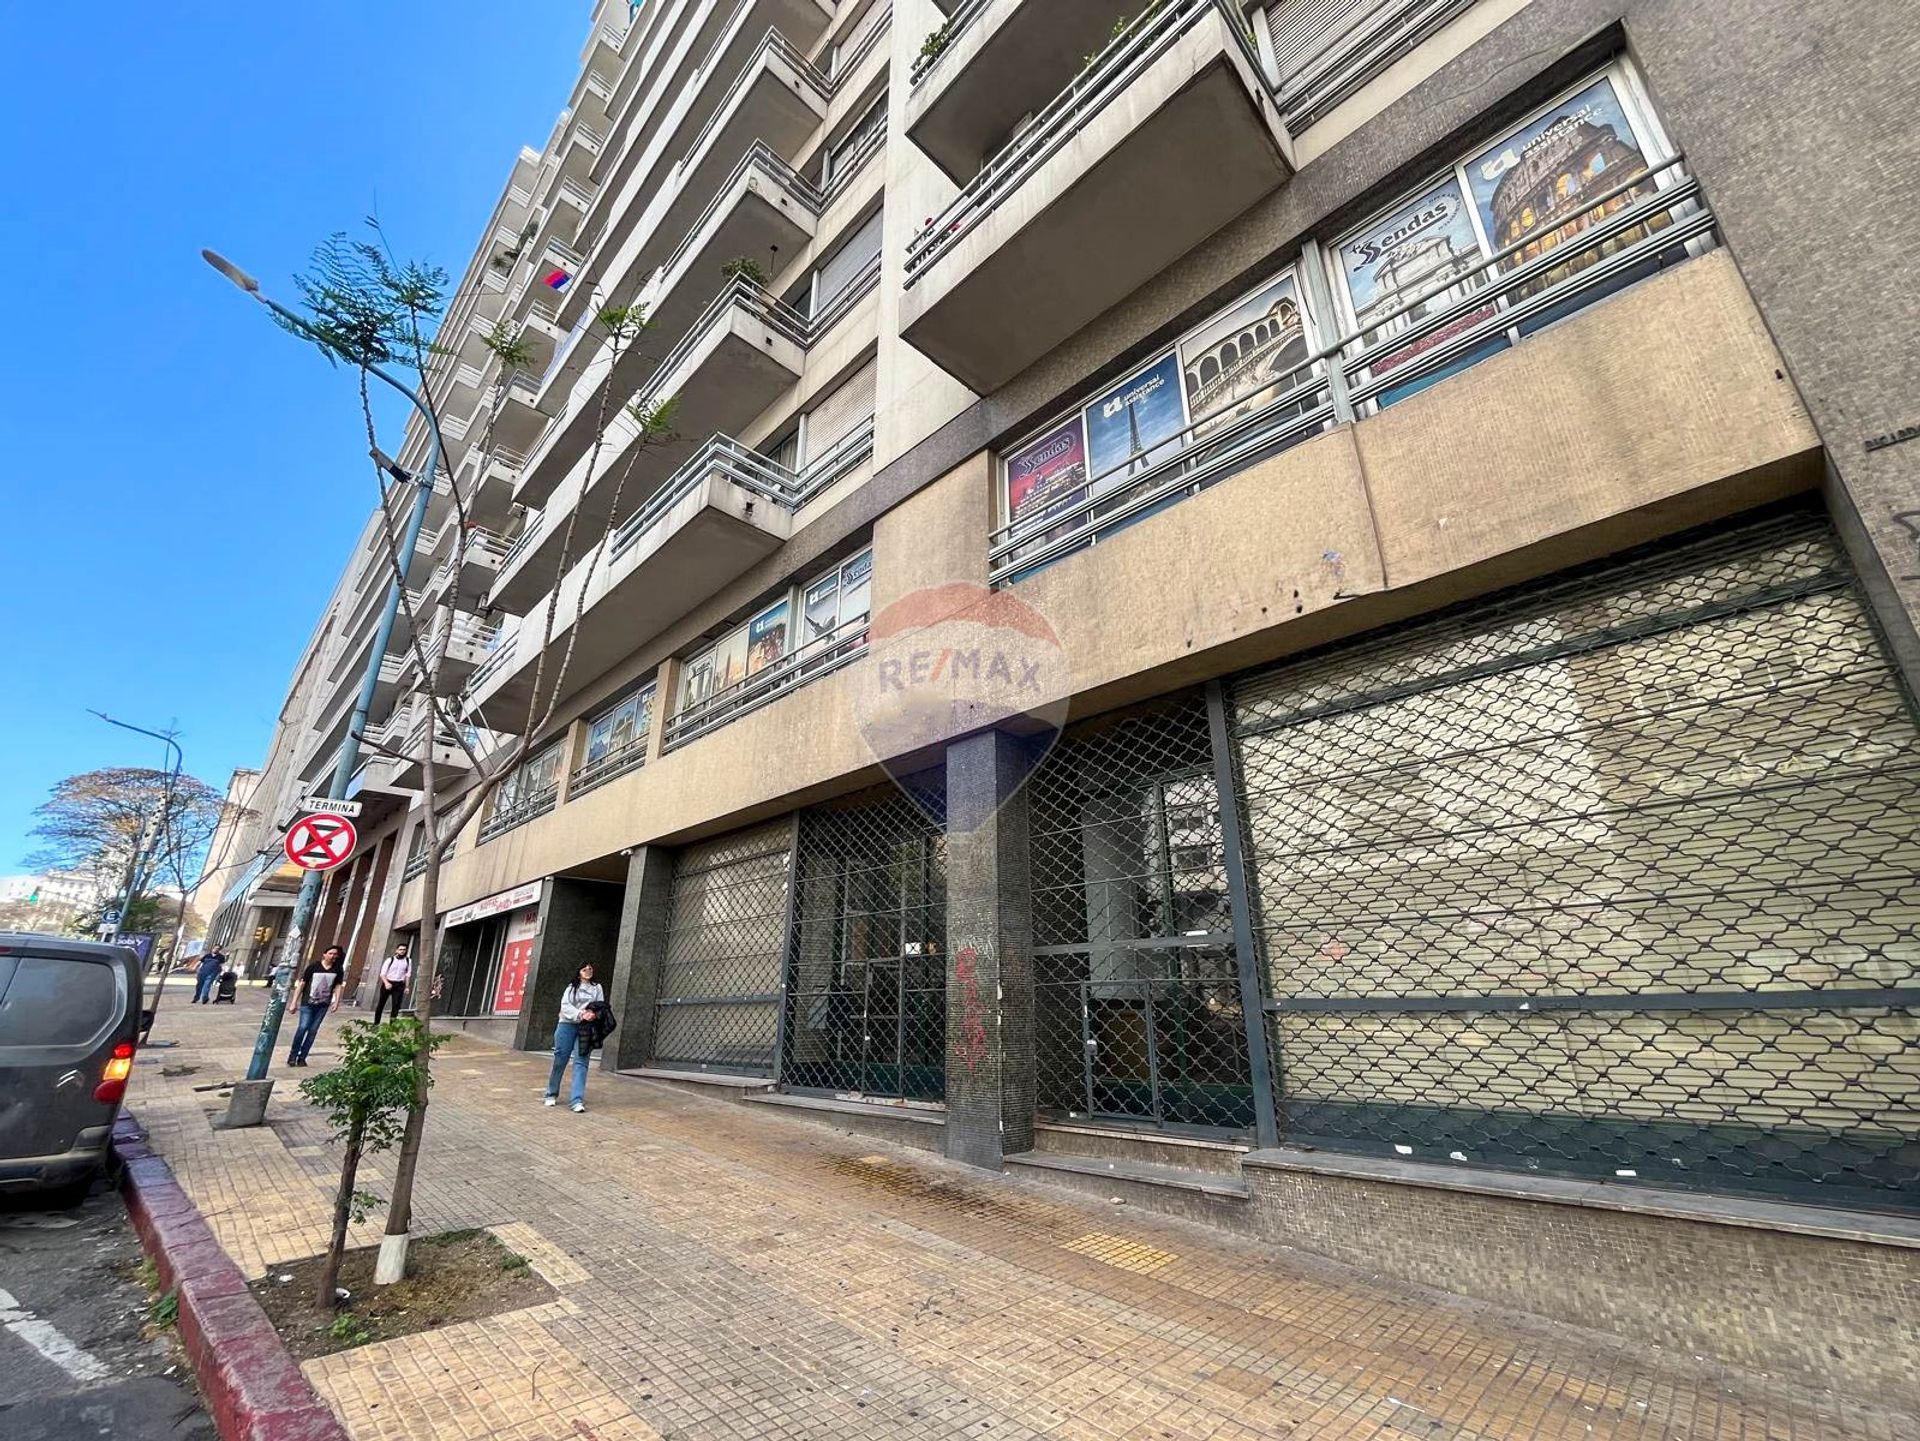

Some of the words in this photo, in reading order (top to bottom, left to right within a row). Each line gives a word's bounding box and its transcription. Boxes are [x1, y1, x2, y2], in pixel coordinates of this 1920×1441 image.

[1522, 104, 1591, 151] universal
[1354, 202, 1447, 272] Sendas
[310, 801, 355, 812] TERMINA
